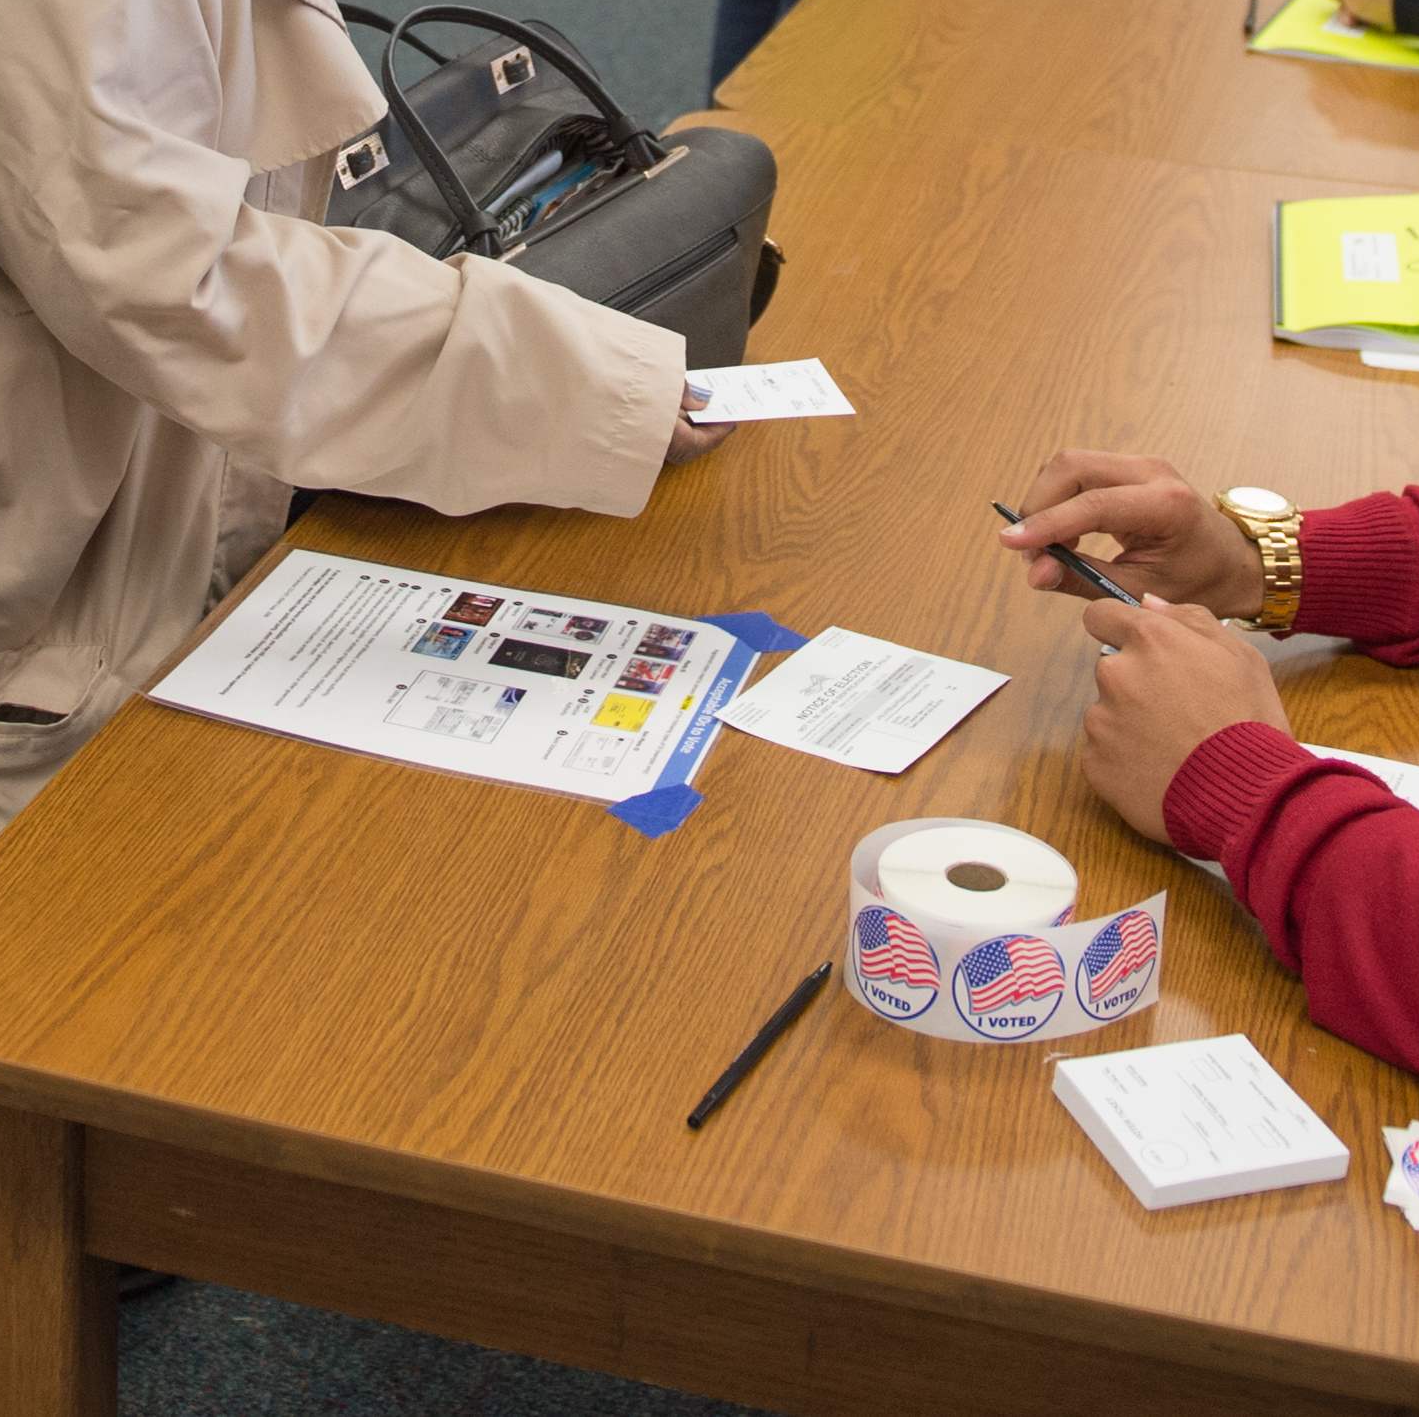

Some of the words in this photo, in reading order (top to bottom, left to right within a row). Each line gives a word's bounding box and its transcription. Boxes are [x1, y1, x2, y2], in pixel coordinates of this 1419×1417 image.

[701, 677, 732, 715] Acceptable
[795, 695, 829, 720] NOTICE
[821, 687, 839, 697] OF
[833, 659, 873, 688] ELECTION
[689, 726, 704, 736] to
[694, 714, 712, 727] IDs
[679, 735, 699, 754] Vote
[870, 988, 912, 1013] VOTED
[1103, 988, 1137, 1011] VOTED
[978, 1017, 983, 1027] I
[988, 1015, 1037, 1028] VOTED
